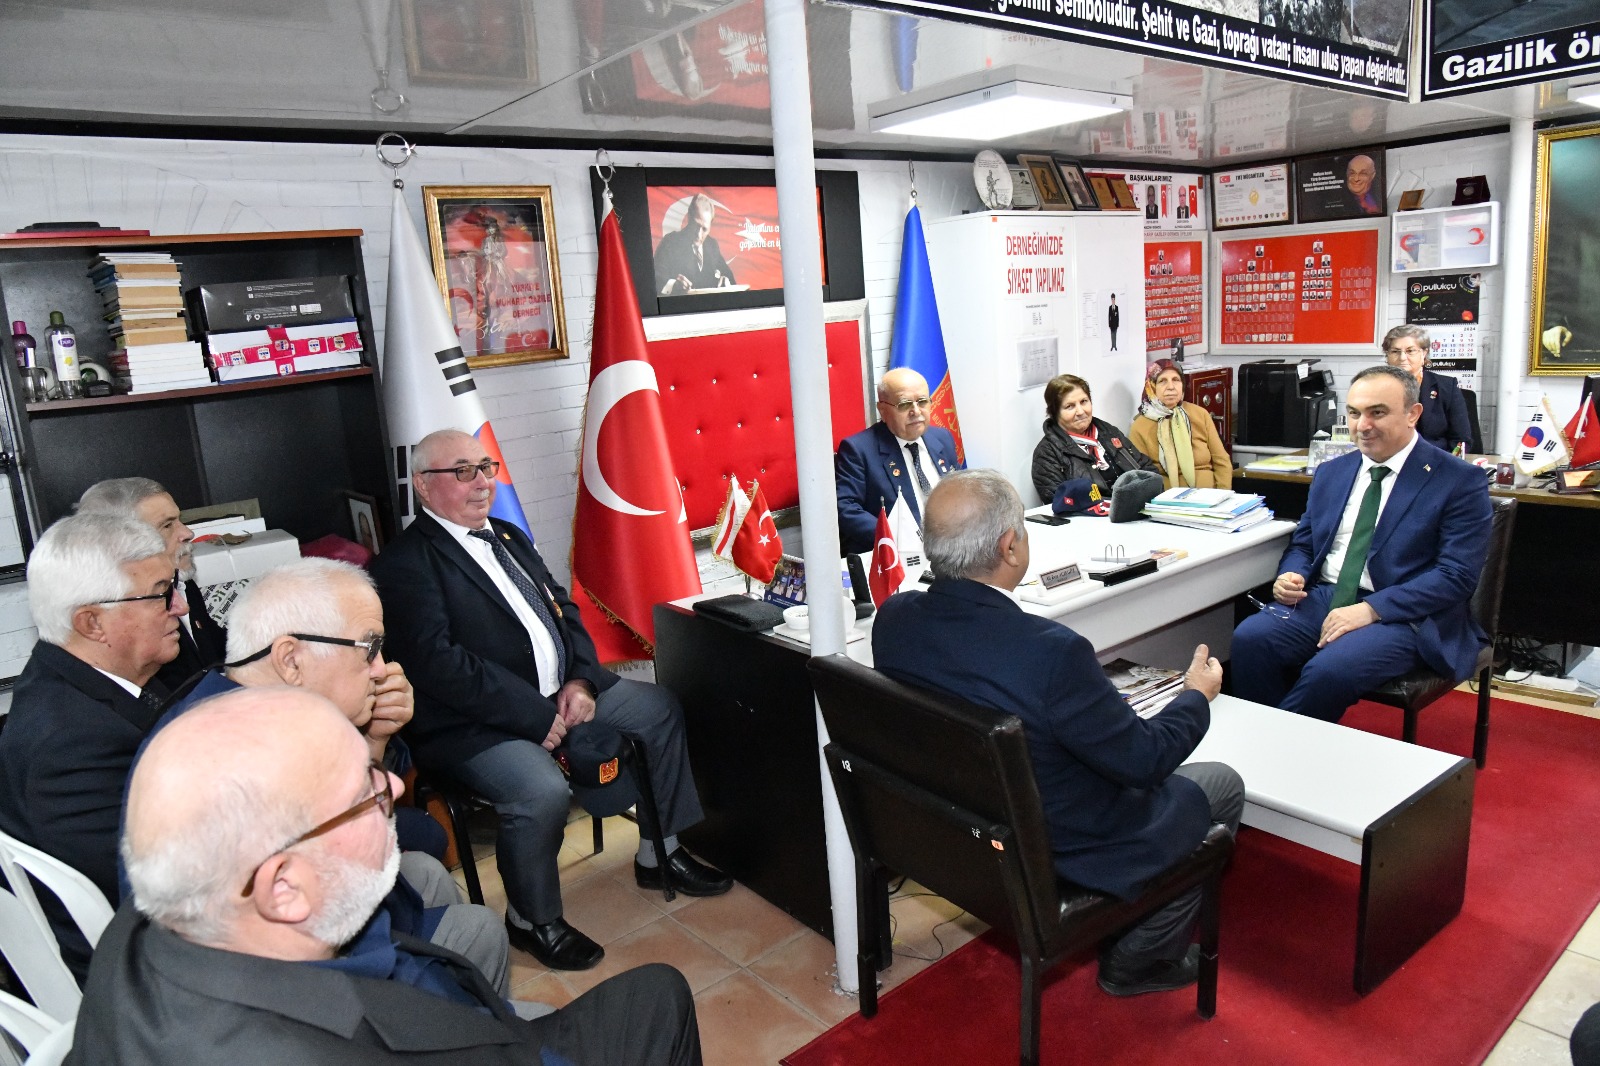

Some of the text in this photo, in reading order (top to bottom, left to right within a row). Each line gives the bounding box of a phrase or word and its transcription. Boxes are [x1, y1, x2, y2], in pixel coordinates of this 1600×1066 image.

[1142, 2, 1174, 40] Şehit
[1175, 17, 1190, 42] ve
[1192, 14, 1220, 54] Gazi,
[1222, 22, 1259, 62] toprağı
[1261, 34, 1291, 68] vatan;
[1293, 37, 1319, 68] insanı
[1321, 45, 1339, 72] ulus
[1340, 54, 1365, 80] yapan
[1365, 55, 1406, 86] değerlerdir.
[1442, 38, 1557, 82] Gazilik
[1006, 231, 1064, 256] DERNEĞİMİZDE
[1007, 262, 1065, 294] SİYASET YAPILMAZ
[1423, 283, 1457, 293] pullukçu
